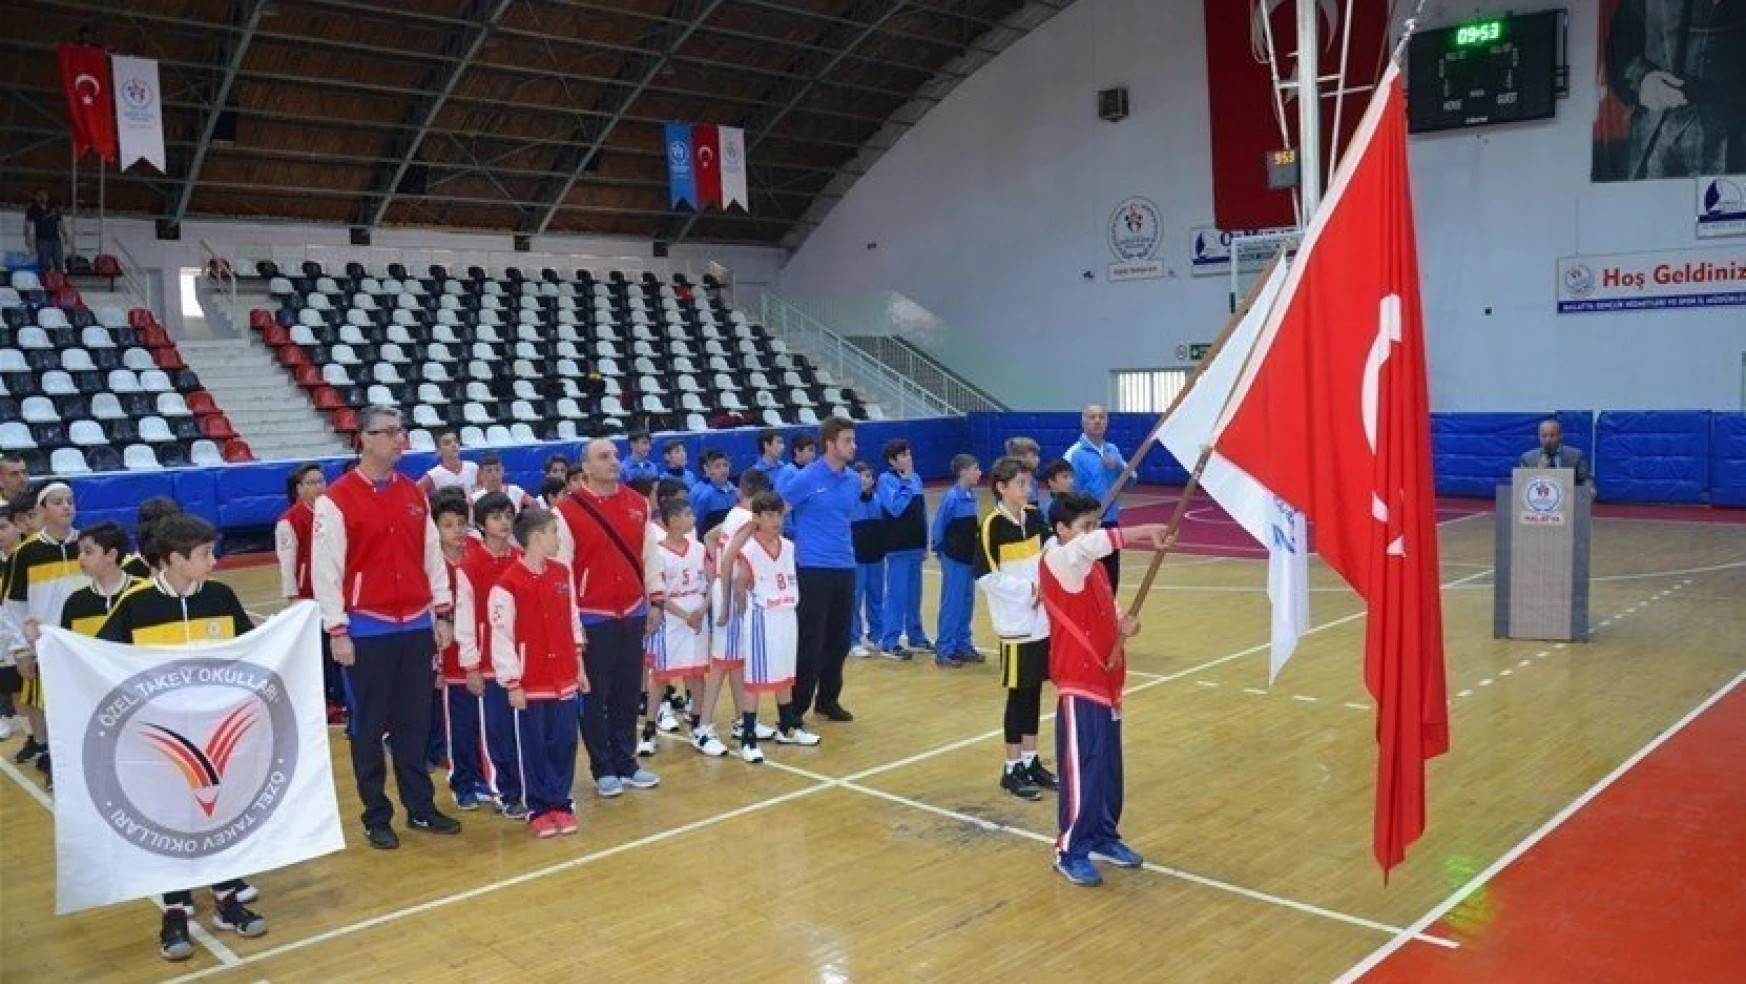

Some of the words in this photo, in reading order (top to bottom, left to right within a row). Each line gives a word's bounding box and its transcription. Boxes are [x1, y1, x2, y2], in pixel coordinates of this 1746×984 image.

[1457, 21, 1499, 45] 09:53
[1602, 267, 1646, 291] Hoş
[1653, 260, 1746, 285] Geldiniz
[100, 691, 141, 728] ÖZEL
[136, 670, 193, 697] TAKEV
[110, 808, 198, 853] OKULLARI
[203, 813, 256, 851] TAKEV
